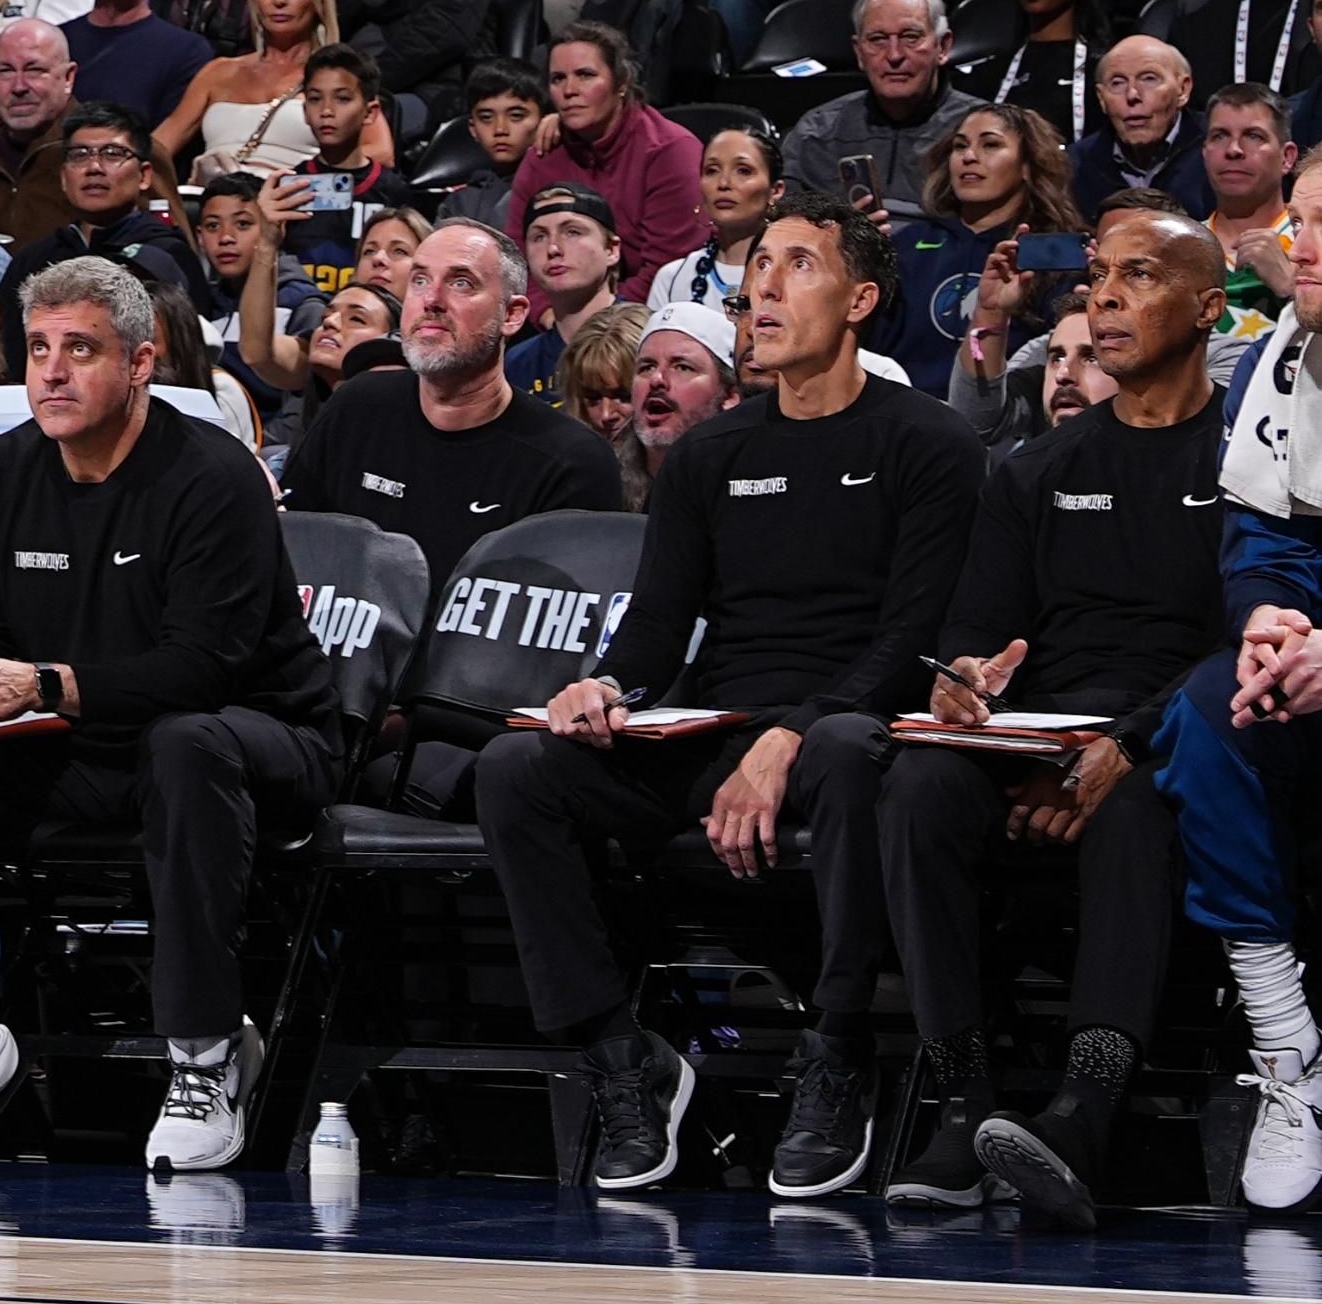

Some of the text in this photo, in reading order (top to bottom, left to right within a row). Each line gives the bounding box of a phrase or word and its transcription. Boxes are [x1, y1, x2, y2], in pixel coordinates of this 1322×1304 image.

[728, 477, 788, 497] TIMBERWOLVES
[1053, 491, 1114, 512] TIMBERWOLVES
[14, 551, 70, 571] TIMBERWOLVES
[308, 584, 383, 658] App
[437, 578, 601, 654] GET THE
